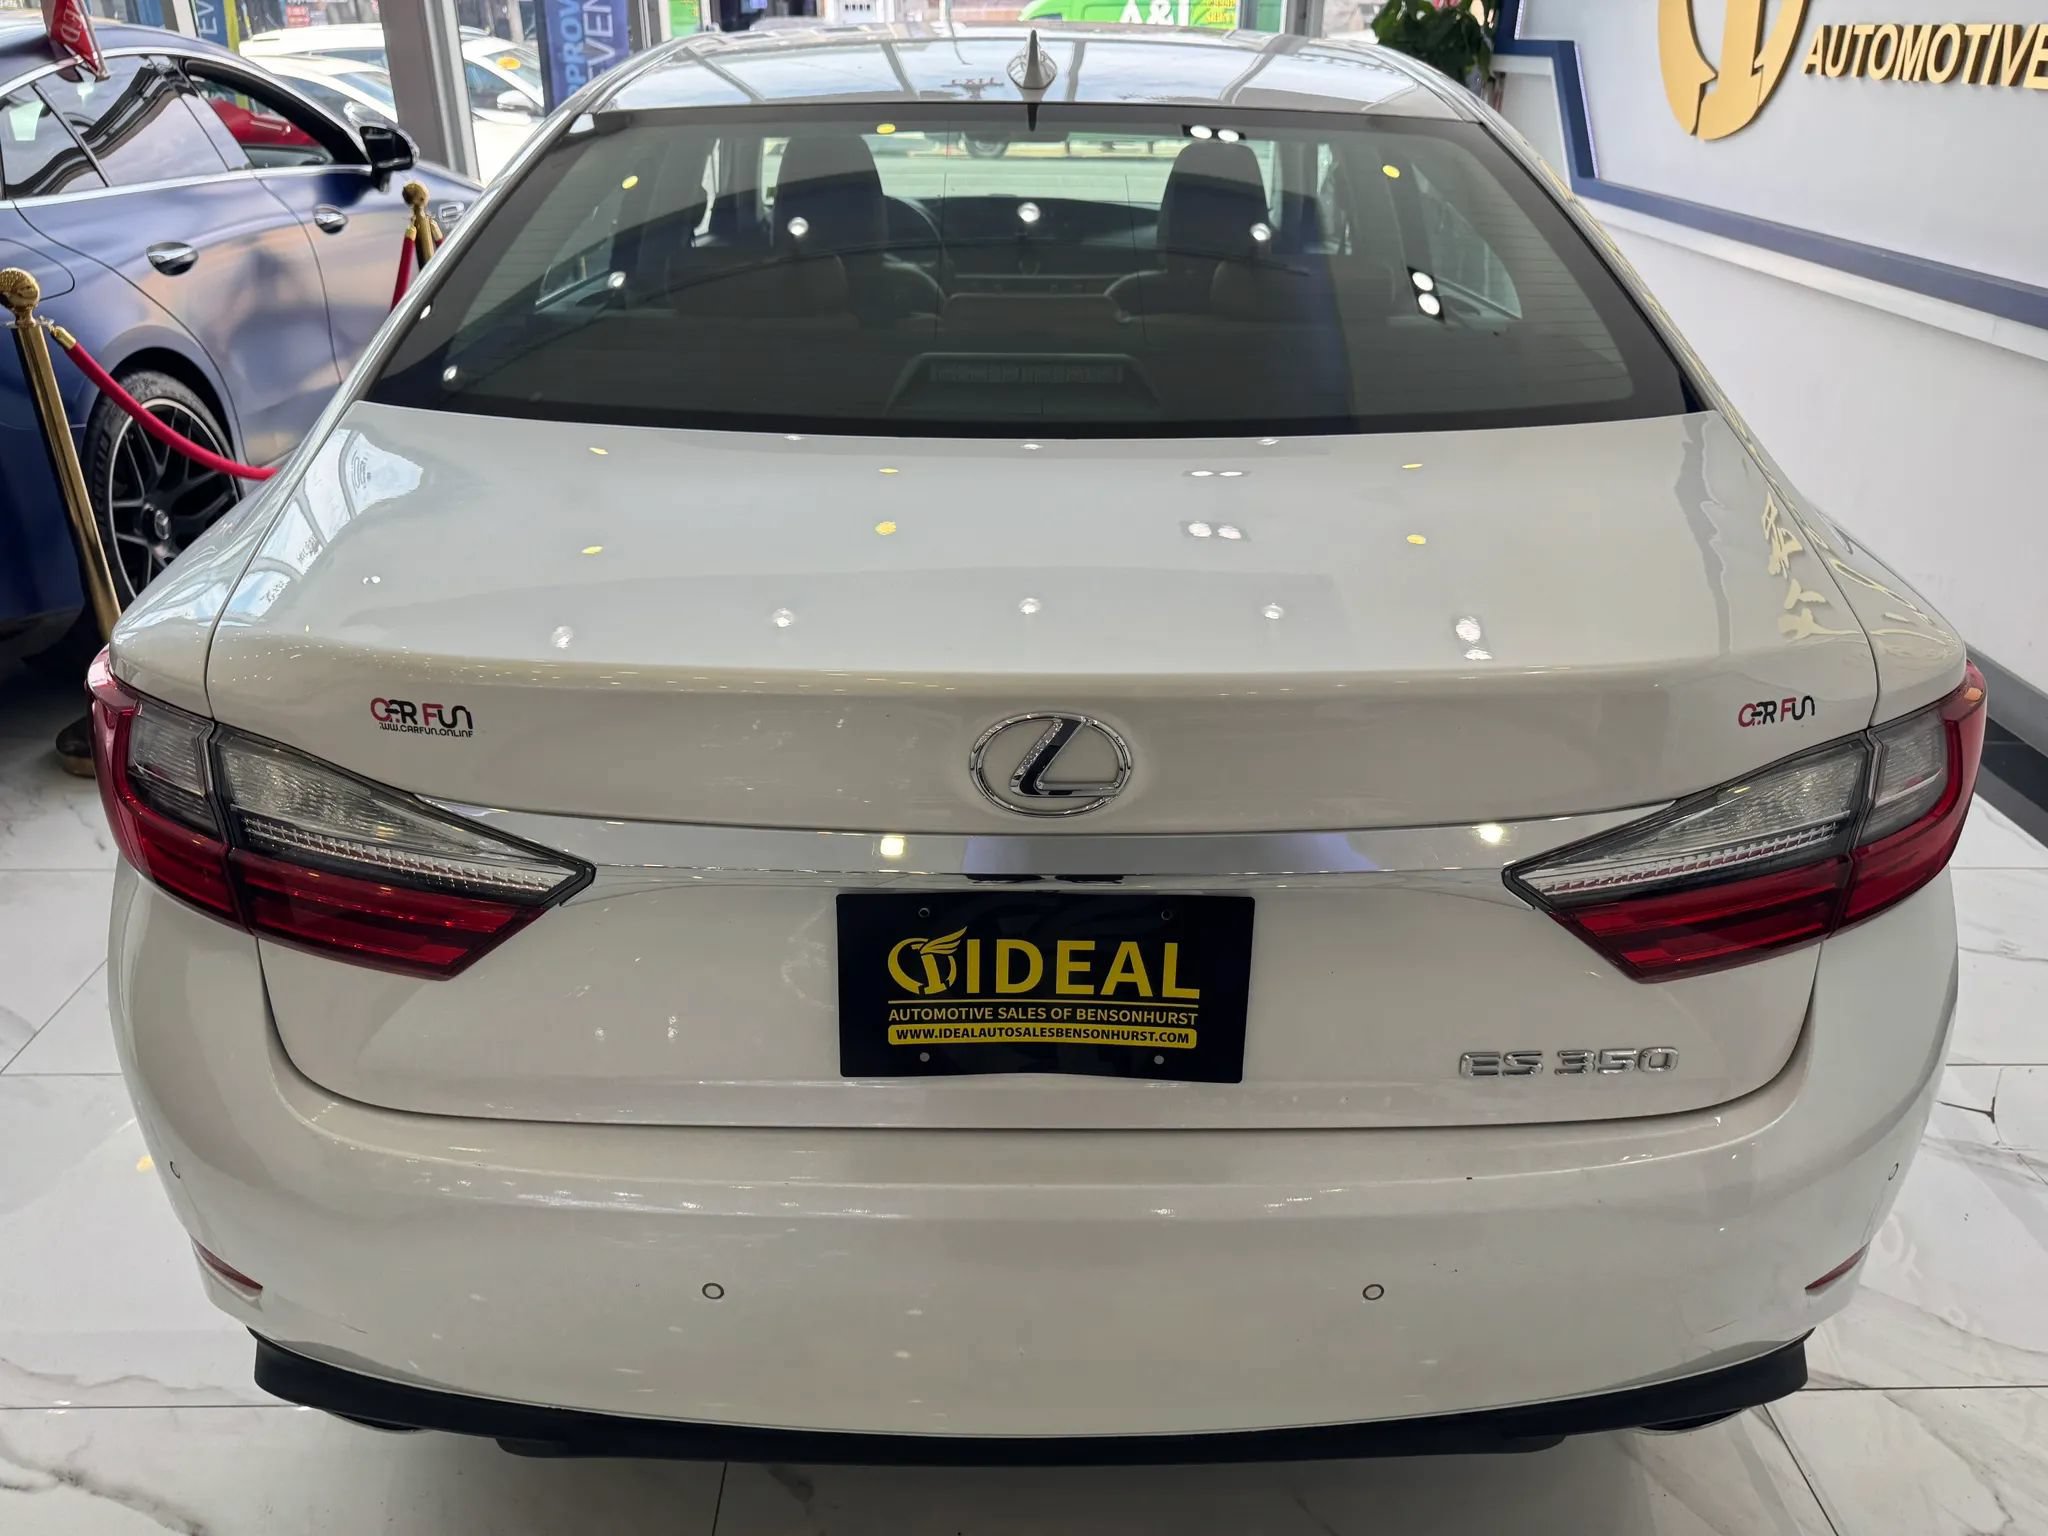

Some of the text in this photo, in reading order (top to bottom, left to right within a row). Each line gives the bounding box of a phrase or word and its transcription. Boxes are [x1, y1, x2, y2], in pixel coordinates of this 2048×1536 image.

[1801, 23, 2048, 90] AUTOMOTIVE
[421, 702, 473, 730] FUN
[1780, 695, 1815, 722] FUN
[967, 938, 1200, 1000] IDEAL
[888, 1006, 1199, 1026] AUTOMOTIVE SALES OF BENSONHURST
[895, 1027, 1190, 1045] WWW.IDEALAUTOSALESBENSONHURST.COM
[1459, 1046, 1680, 1077] ES 350
